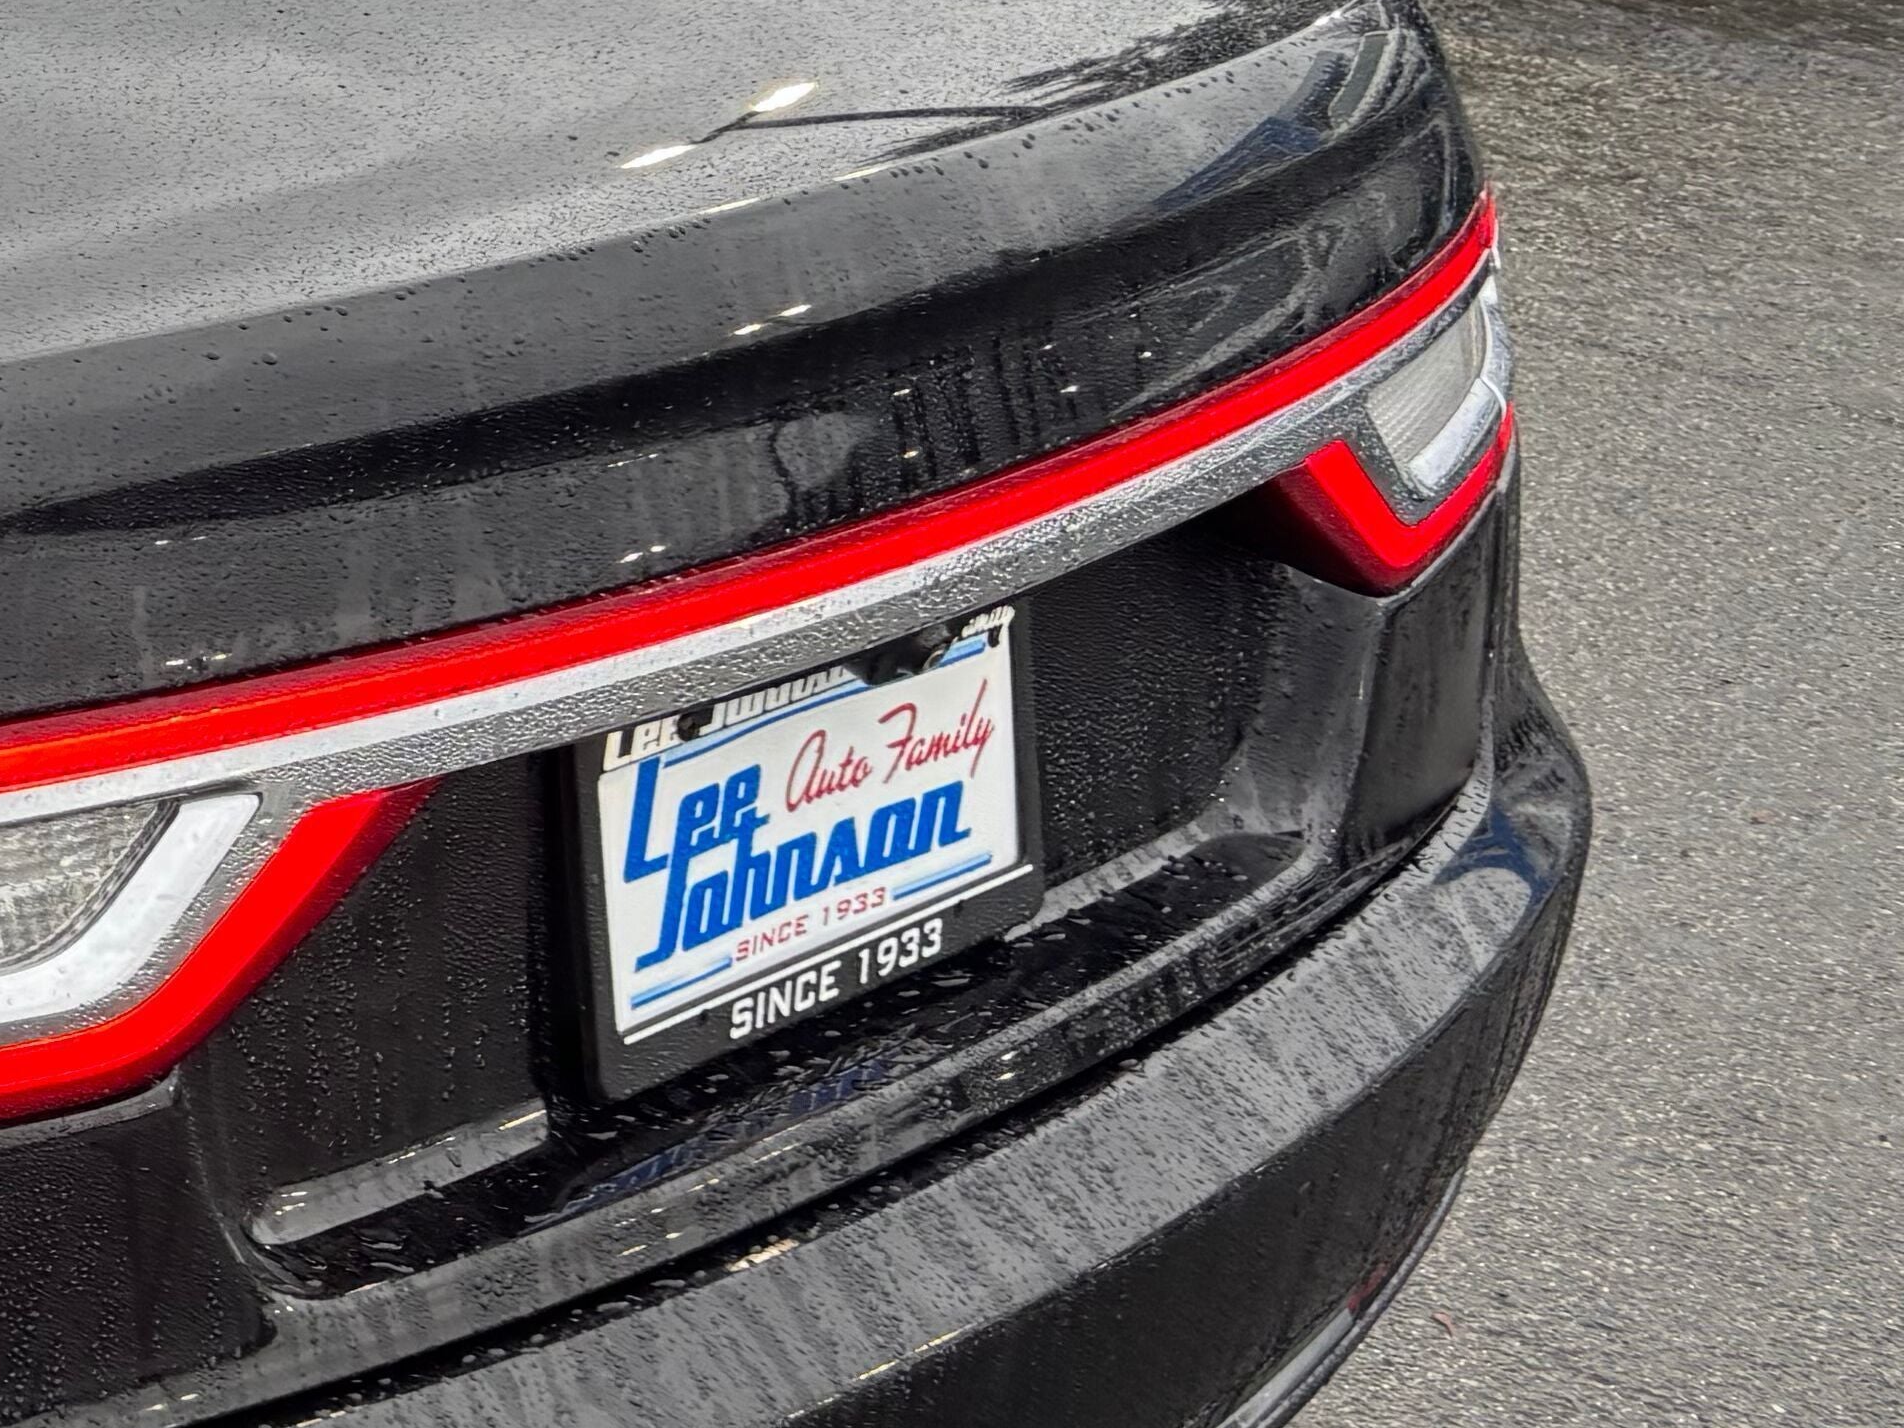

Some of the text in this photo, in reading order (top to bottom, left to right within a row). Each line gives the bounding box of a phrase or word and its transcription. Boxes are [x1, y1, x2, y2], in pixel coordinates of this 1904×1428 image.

[786, 678, 996, 813] Auto Family
[624, 756, 761, 884] Lee
[635, 780, 972, 973] Johnson
[729, 917, 944, 1030] SINCE 1933
[735, 886, 887, 962] SINCE 1933
